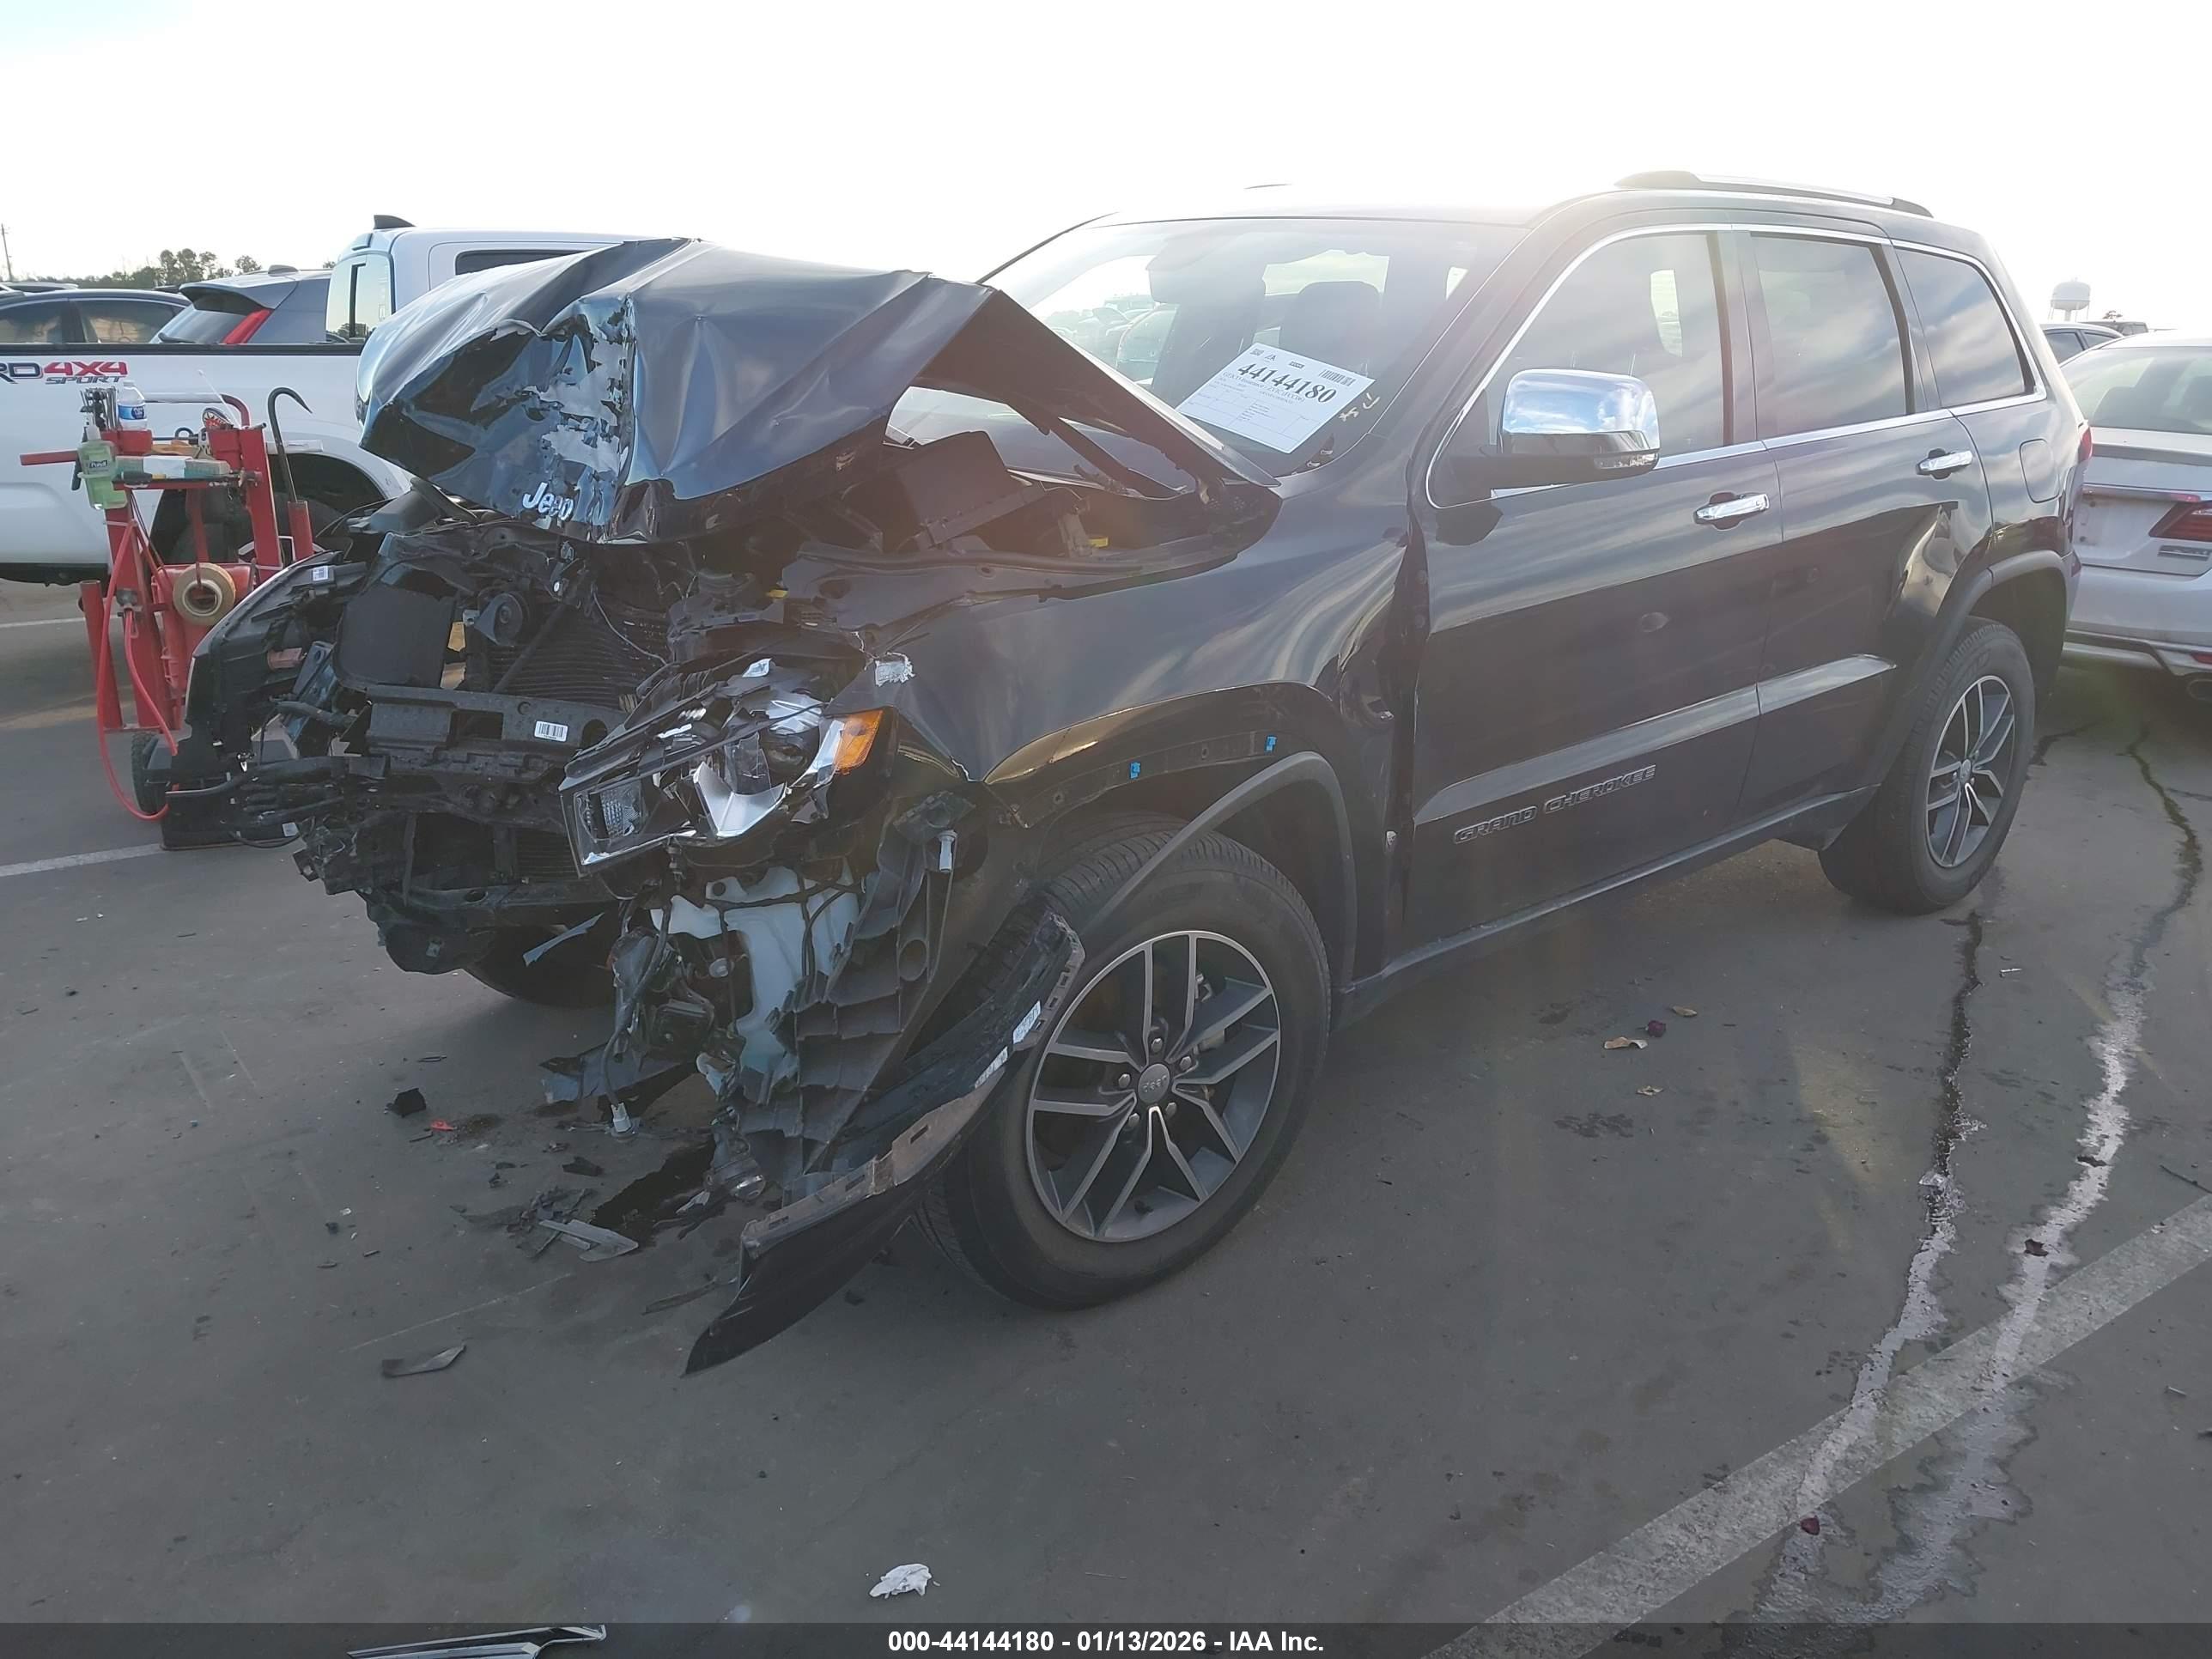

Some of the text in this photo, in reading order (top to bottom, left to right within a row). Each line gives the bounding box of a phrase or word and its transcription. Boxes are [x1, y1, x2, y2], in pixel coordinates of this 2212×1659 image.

[46, 375, 126, 385] SPORT
[1237, 363, 1337, 403] 44144180
[1454, 764, 1656, 844] GRAND CHEROKEE
